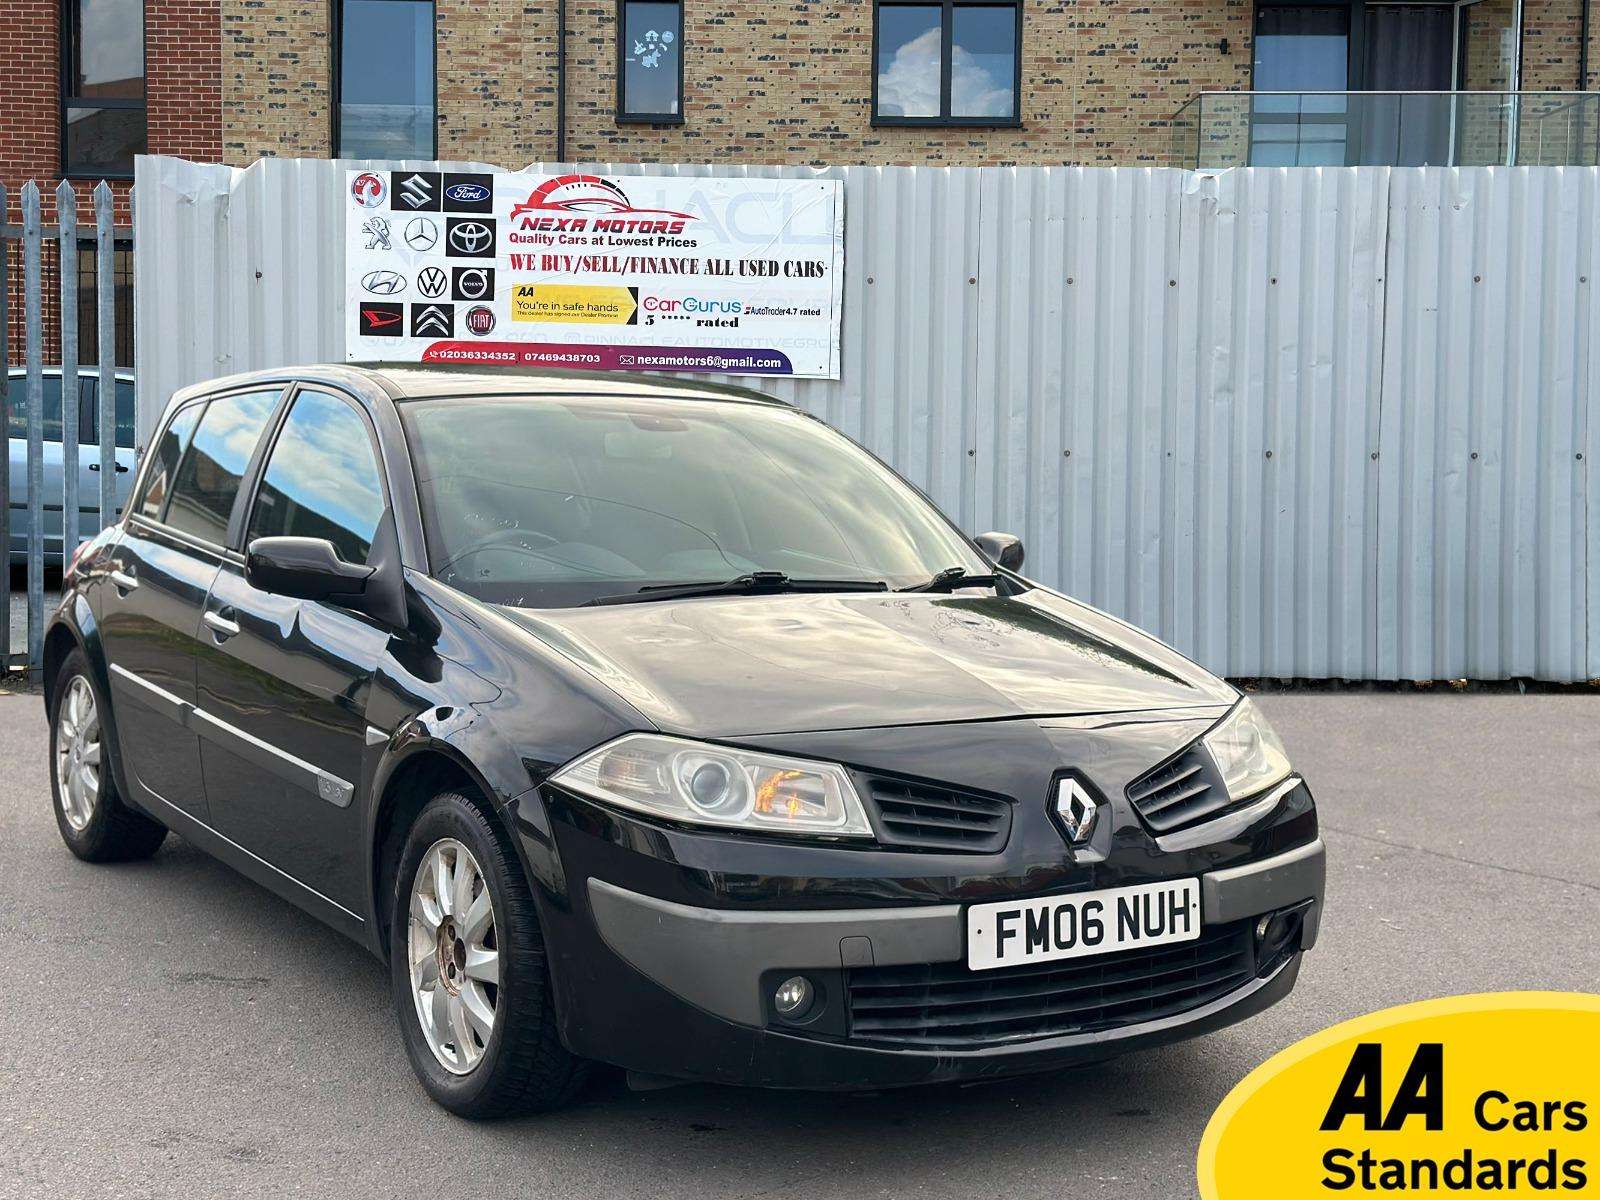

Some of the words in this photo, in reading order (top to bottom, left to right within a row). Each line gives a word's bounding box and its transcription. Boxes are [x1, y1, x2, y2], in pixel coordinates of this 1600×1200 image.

[454, 186, 481, 199] Ford
[520, 217, 589, 232] NEXA
[592, 219, 686, 234] MOTORS
[509, 232, 555, 246] Quality
[558, 233, 587, 245] Cars
[591, 235, 604, 246] at
[608, 236, 653, 247] Lowest
[658, 236, 697, 248] Prices
[510, 253, 536, 271] WE
[541, 254, 699, 276] BUY/SELL/FINANCE
[704, 258, 734, 276] ALL
[739, 259, 779, 277] USED
[783, 260, 825, 278] CARS
[518, 286, 534, 297] AA
[516, 300, 549, 310] You're
[551, 301, 560, 310] in
[563, 302, 584, 311] safe
[587, 302, 619, 312] hands
[643, 296, 742, 313] CarGurus
[799, 308, 821, 316] rated
[472, 314, 490, 328] FIAT
[645, 314, 655, 326] 5
[696, 317, 739, 328] rated
[524, 352, 601, 363] 07469438703
[637, 355, 781, 369] nexamotors6@gmail.com
[996, 899, 1104, 959] FM06
[1117, 888, 1191, 942] NUH
